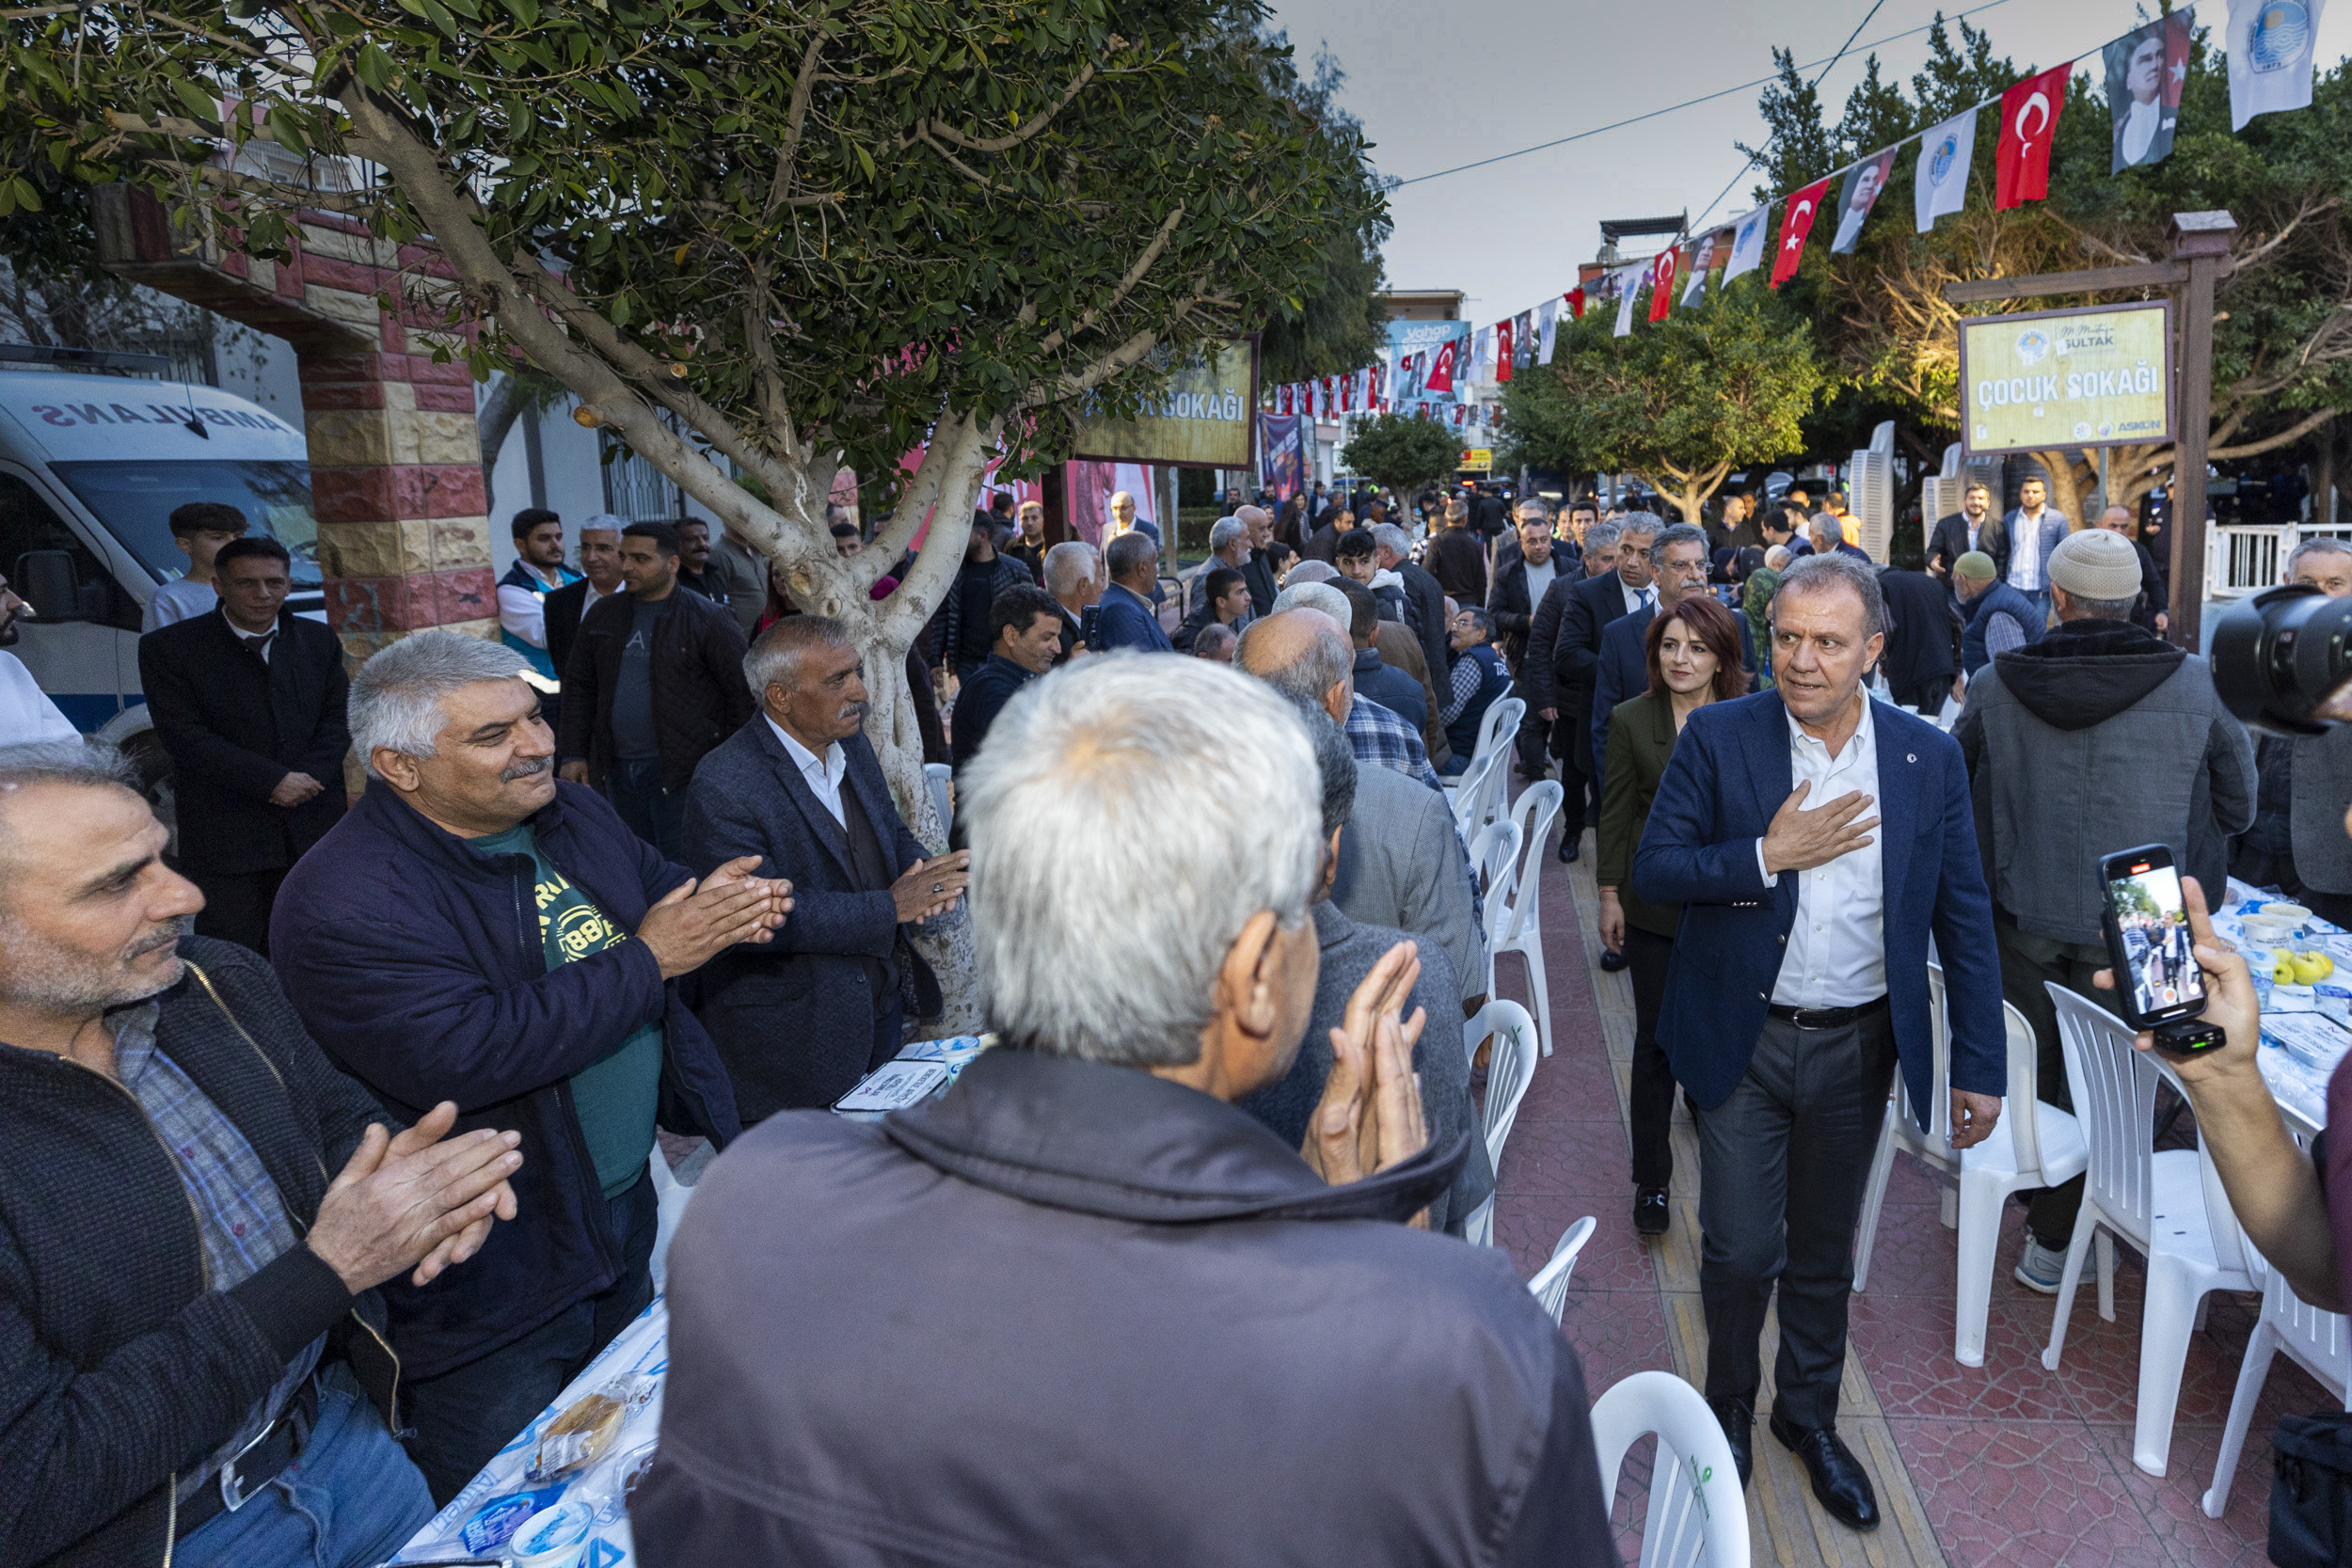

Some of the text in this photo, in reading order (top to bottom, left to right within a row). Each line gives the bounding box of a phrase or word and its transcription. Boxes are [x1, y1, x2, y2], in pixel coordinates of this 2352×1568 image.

[1407, 325, 1452, 339] Vahap
[1978, 359, 2159, 413] ÇOCUK SOKAĞI
[1161, 388, 1245, 422] SOKAĞI
[564, 919, 604, 952] 88
